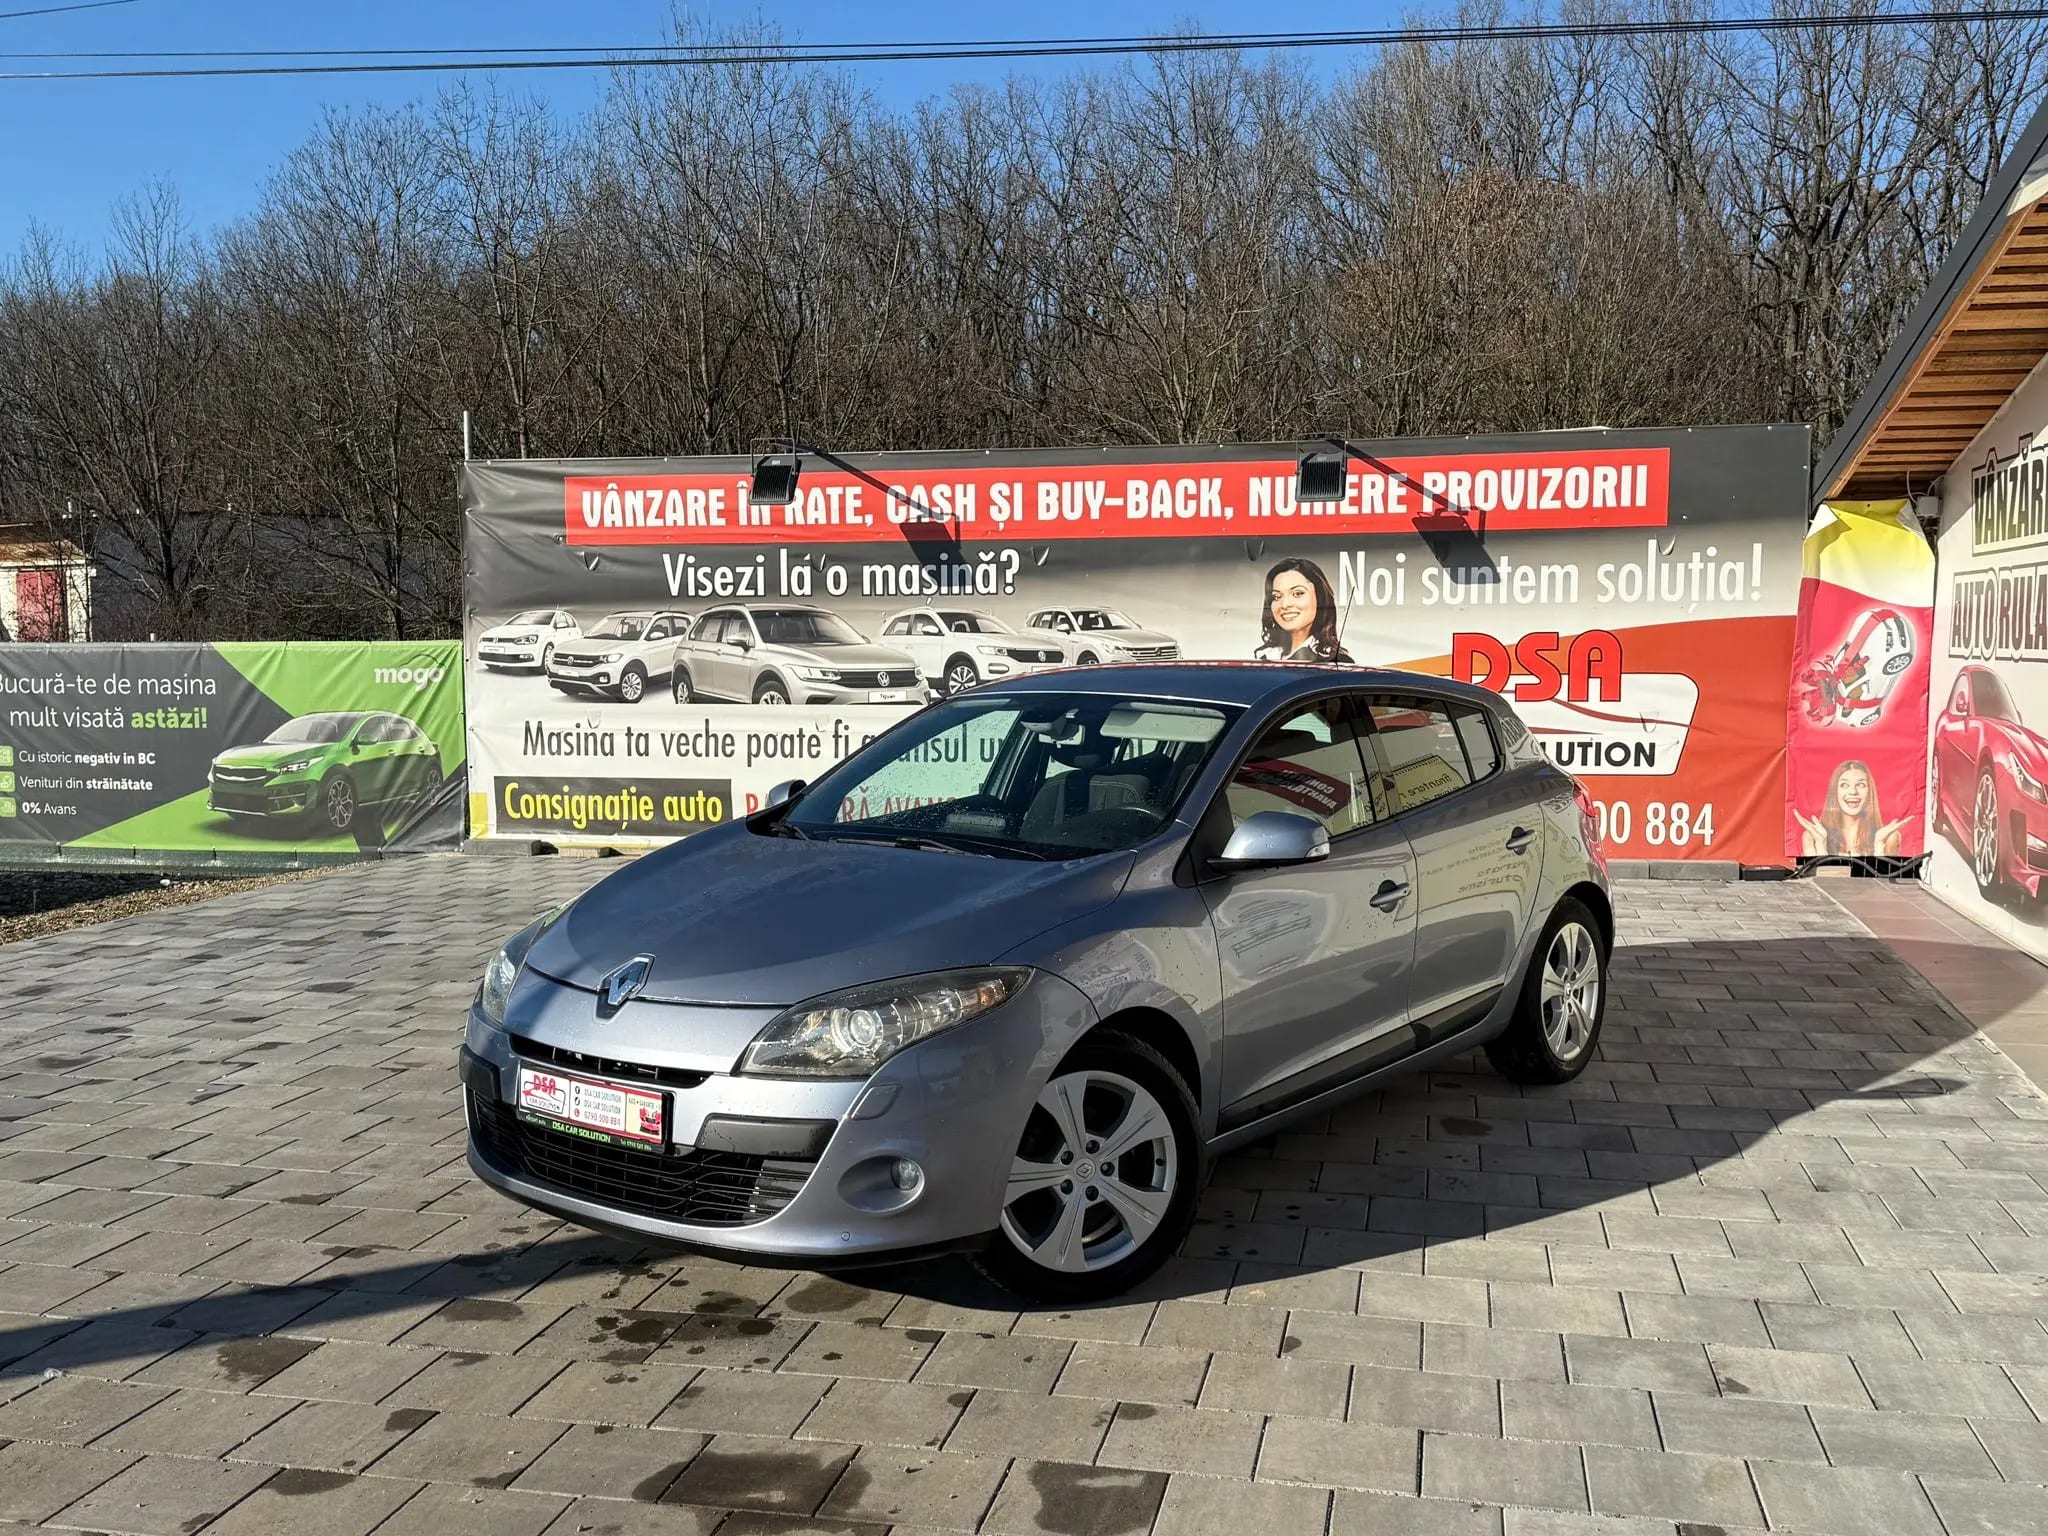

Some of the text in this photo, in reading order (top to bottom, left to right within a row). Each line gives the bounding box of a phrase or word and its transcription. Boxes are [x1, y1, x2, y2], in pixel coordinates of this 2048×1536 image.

[582, 483, 726, 527] VÂNZARE
[785, 485, 873, 527] RATE,
[887, 483, 975, 523] CASH
[989, 481, 1022, 531] ȘI
[1038, 478, 1233, 521] BUY-BACK,
[1423, 464, 1647, 513] PROVIZORII
[662, 547, 1021, 604] Visezi la o mașină?
[1339, 538, 1762, 613] Noi suntem soluția!
[1952, 577, 1997, 651] AUTO
[1452, 629, 1622, 702] DSA
[103, 673, 131, 695] de
[138, 673, 216, 700] mașina
[374, 667, 444, 692] mogo
[9, 706, 208, 729] mult visată astăzi!
[625, 726, 650, 757] ta
[661, 718, 736, 758] veche
[747, 727, 822, 767] poate
[832, 719, 850, 760] fi
[1540, 741, 1656, 767] UTION
[19, 751, 156, 767] Cu istoric negativ in BC
[20, 776, 153, 790] Venituri din străinătate
[22, 801, 77, 815] 0% Avans
[504, 782, 655, 830] Consignație
[663, 790, 723, 823] auto
[1645, 800, 1714, 846] 884
[534, 1074, 556, 1095] DSA
[552, 1121, 611, 1144] DSA CAR SOLUTION
